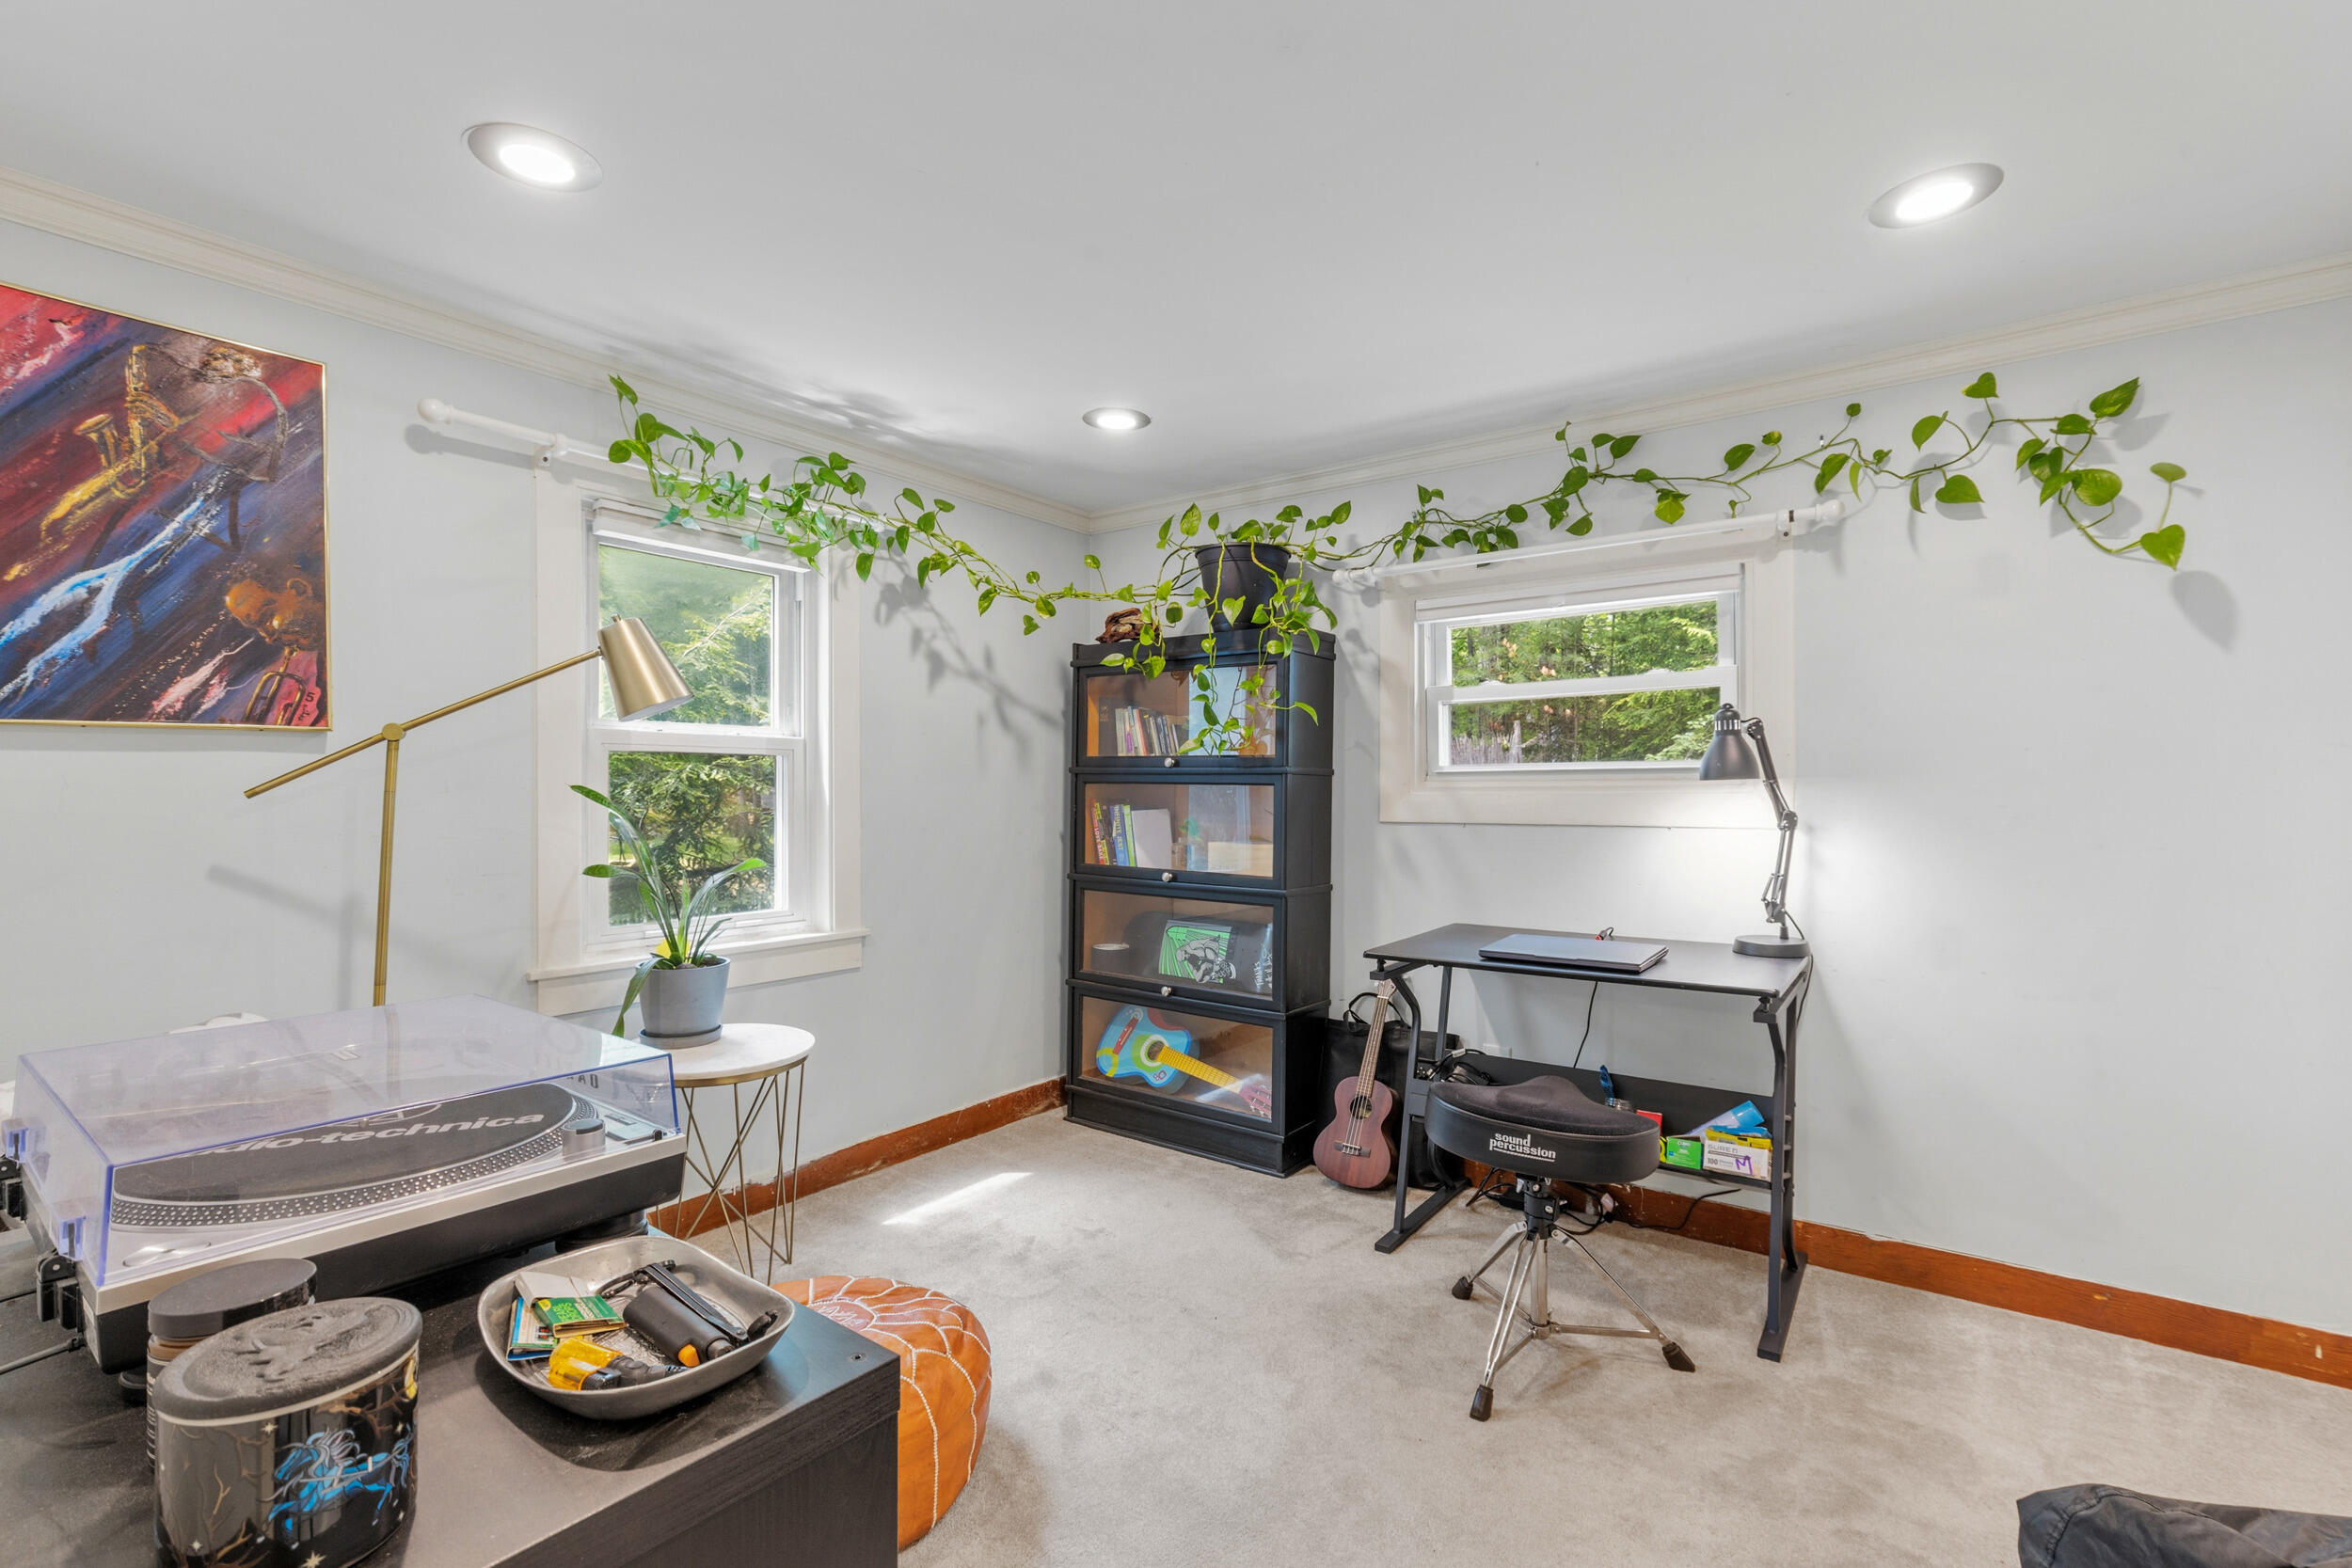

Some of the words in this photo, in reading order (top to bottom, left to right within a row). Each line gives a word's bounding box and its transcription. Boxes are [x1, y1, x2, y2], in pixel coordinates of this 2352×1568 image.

[191, 1114, 545, 1156] dio-technica
[1494, 1132, 1532, 1148] sound
[1489, 1138, 1556, 1159] percussion
[1707, 1156, 1719, 1166] 100
